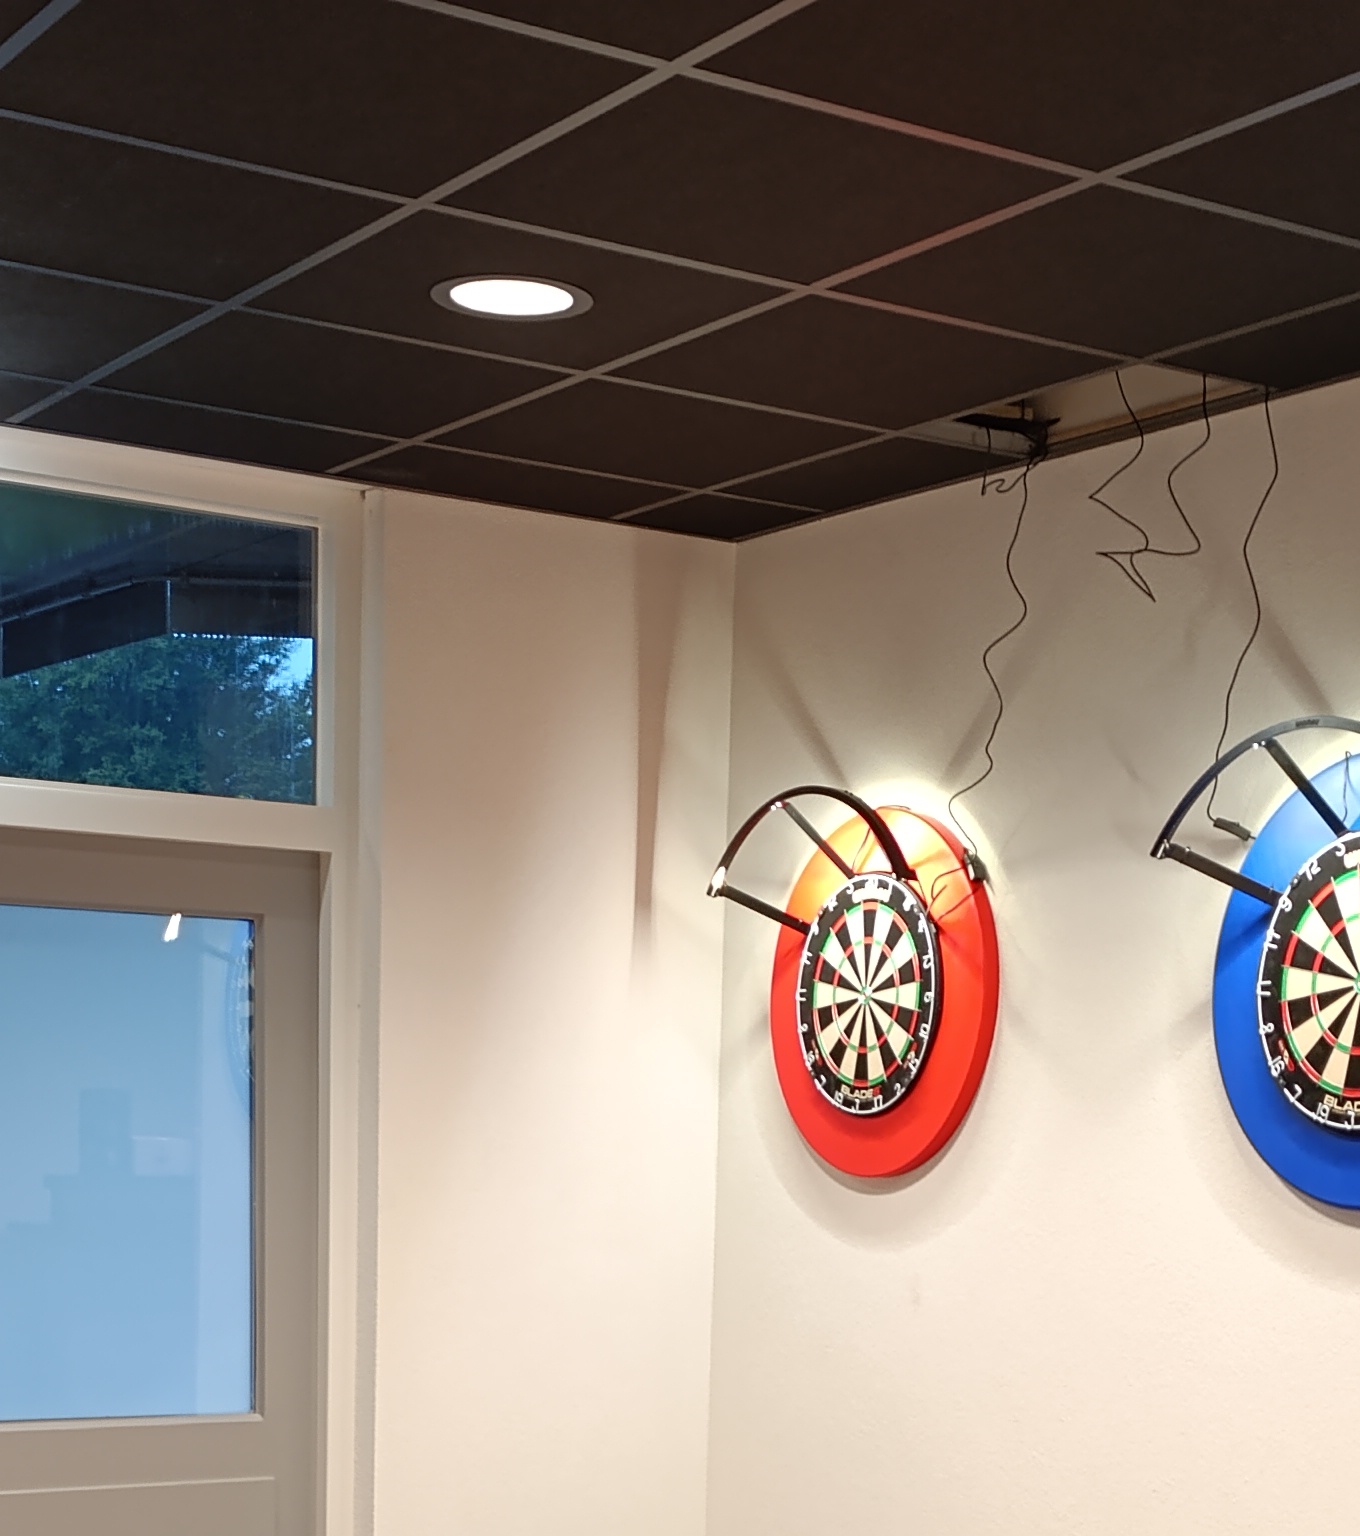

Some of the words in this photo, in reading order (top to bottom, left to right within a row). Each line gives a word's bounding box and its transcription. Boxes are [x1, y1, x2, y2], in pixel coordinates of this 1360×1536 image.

[1303, 860, 1321, 881] 12
[1291, 1083, 1303, 1102] 7
[1315, 1102, 1331, 1123] 19
